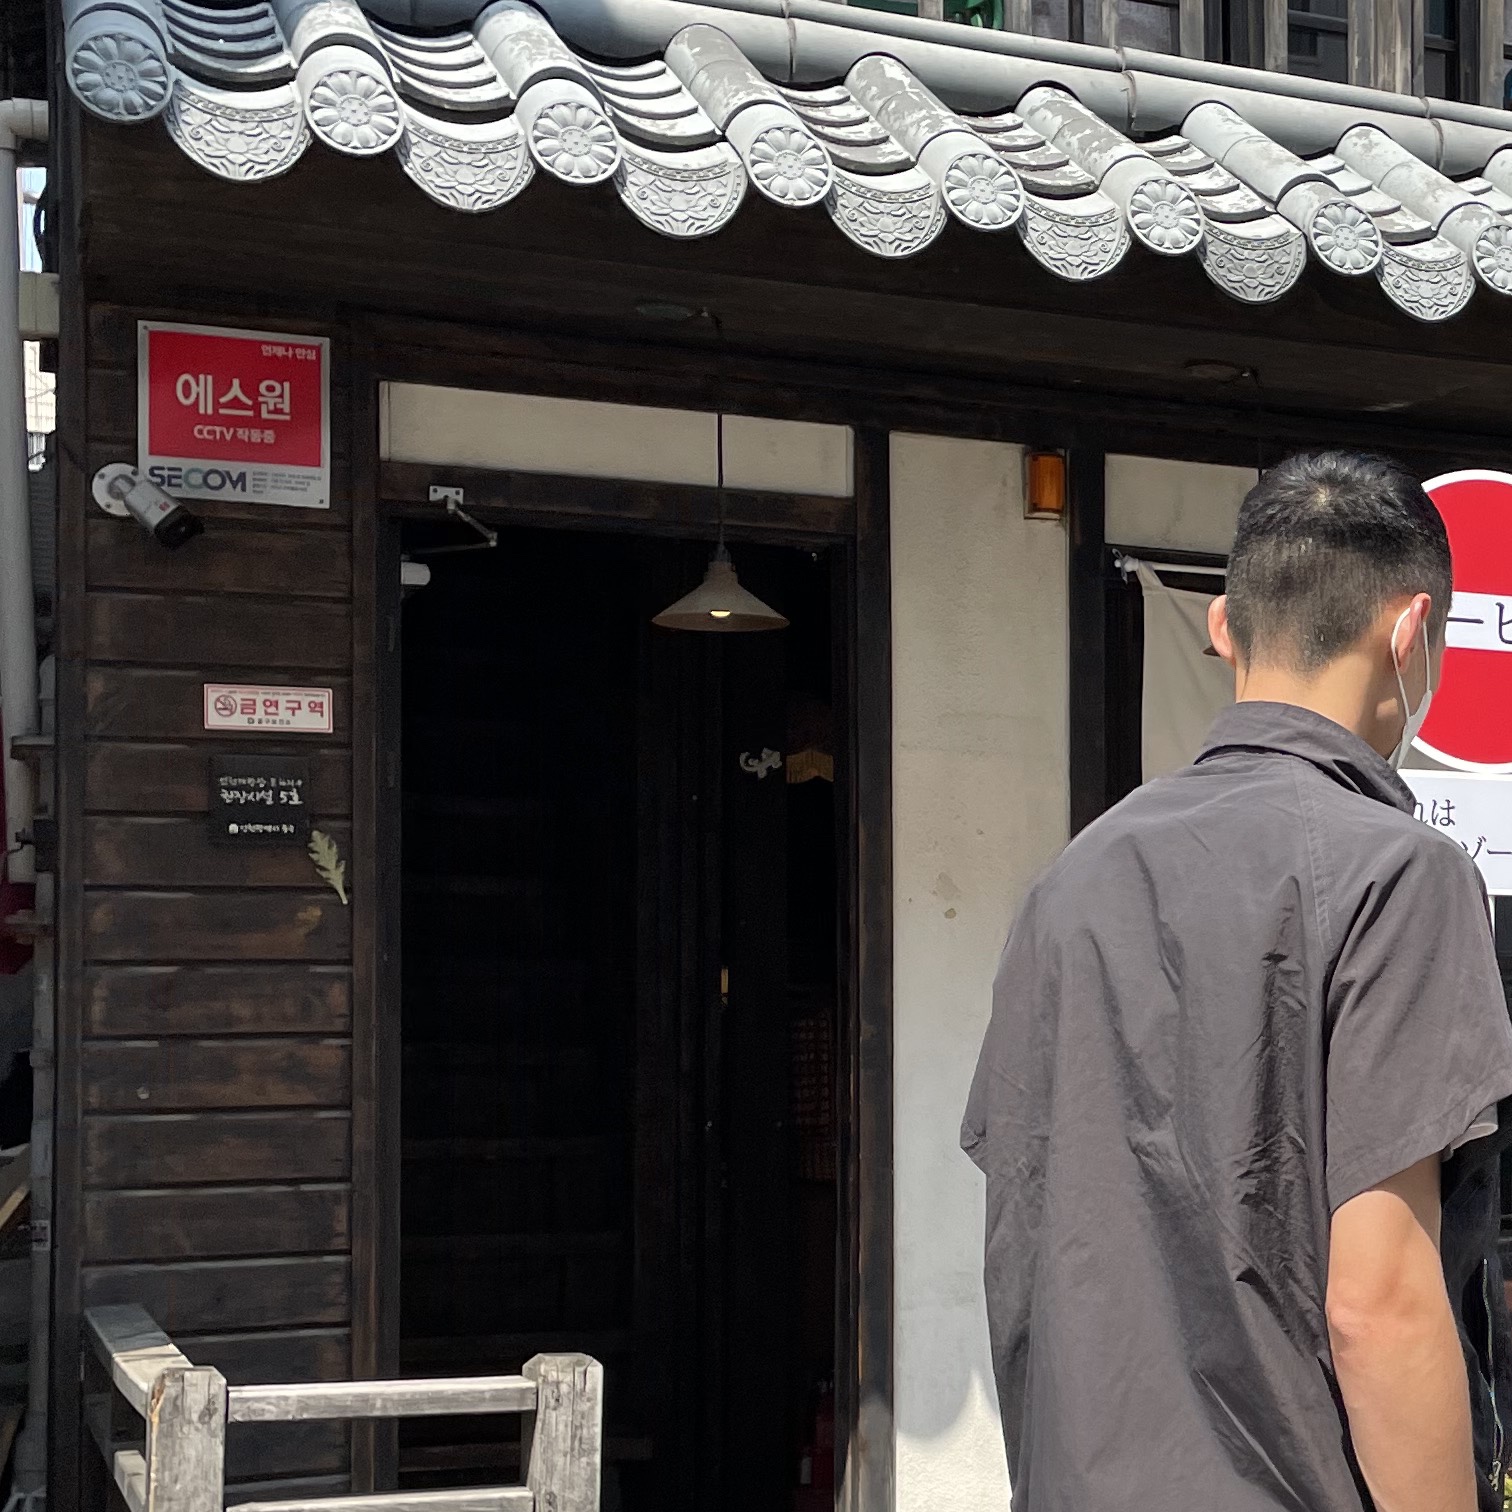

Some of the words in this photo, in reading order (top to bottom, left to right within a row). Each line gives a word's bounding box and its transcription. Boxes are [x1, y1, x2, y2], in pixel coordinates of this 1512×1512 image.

[175, 373, 291, 421] 에스원
[193, 424, 234, 441] CCTV
[148, 465, 247, 493] SECOM
[240, 697, 324, 718] 금연구역
